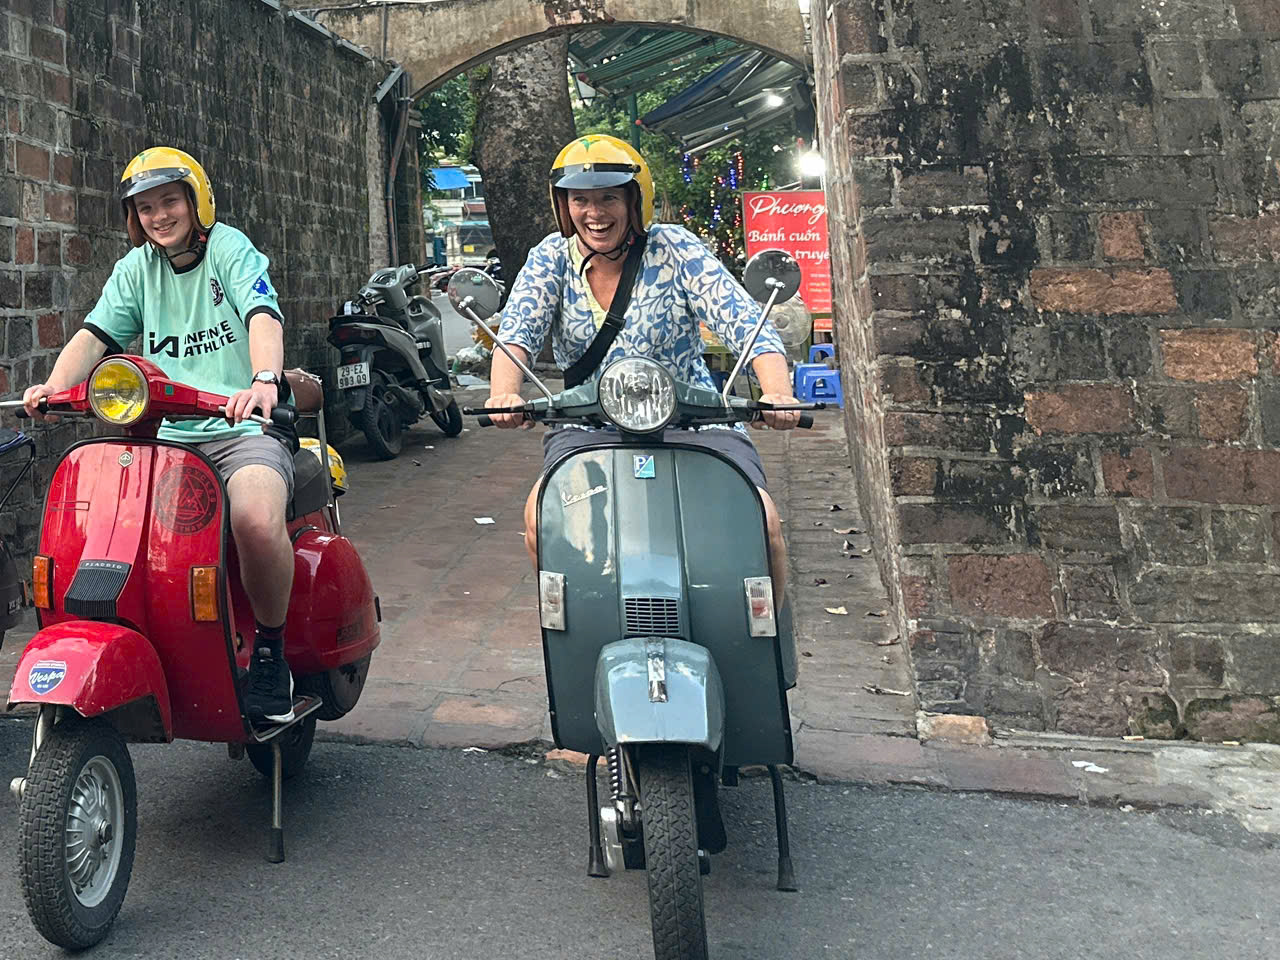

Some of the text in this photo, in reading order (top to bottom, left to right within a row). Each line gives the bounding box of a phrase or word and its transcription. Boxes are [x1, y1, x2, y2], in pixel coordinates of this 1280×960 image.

[748, 226, 821, 243] Bánh cuốn
[30, 670, 65, 685] Vespa
